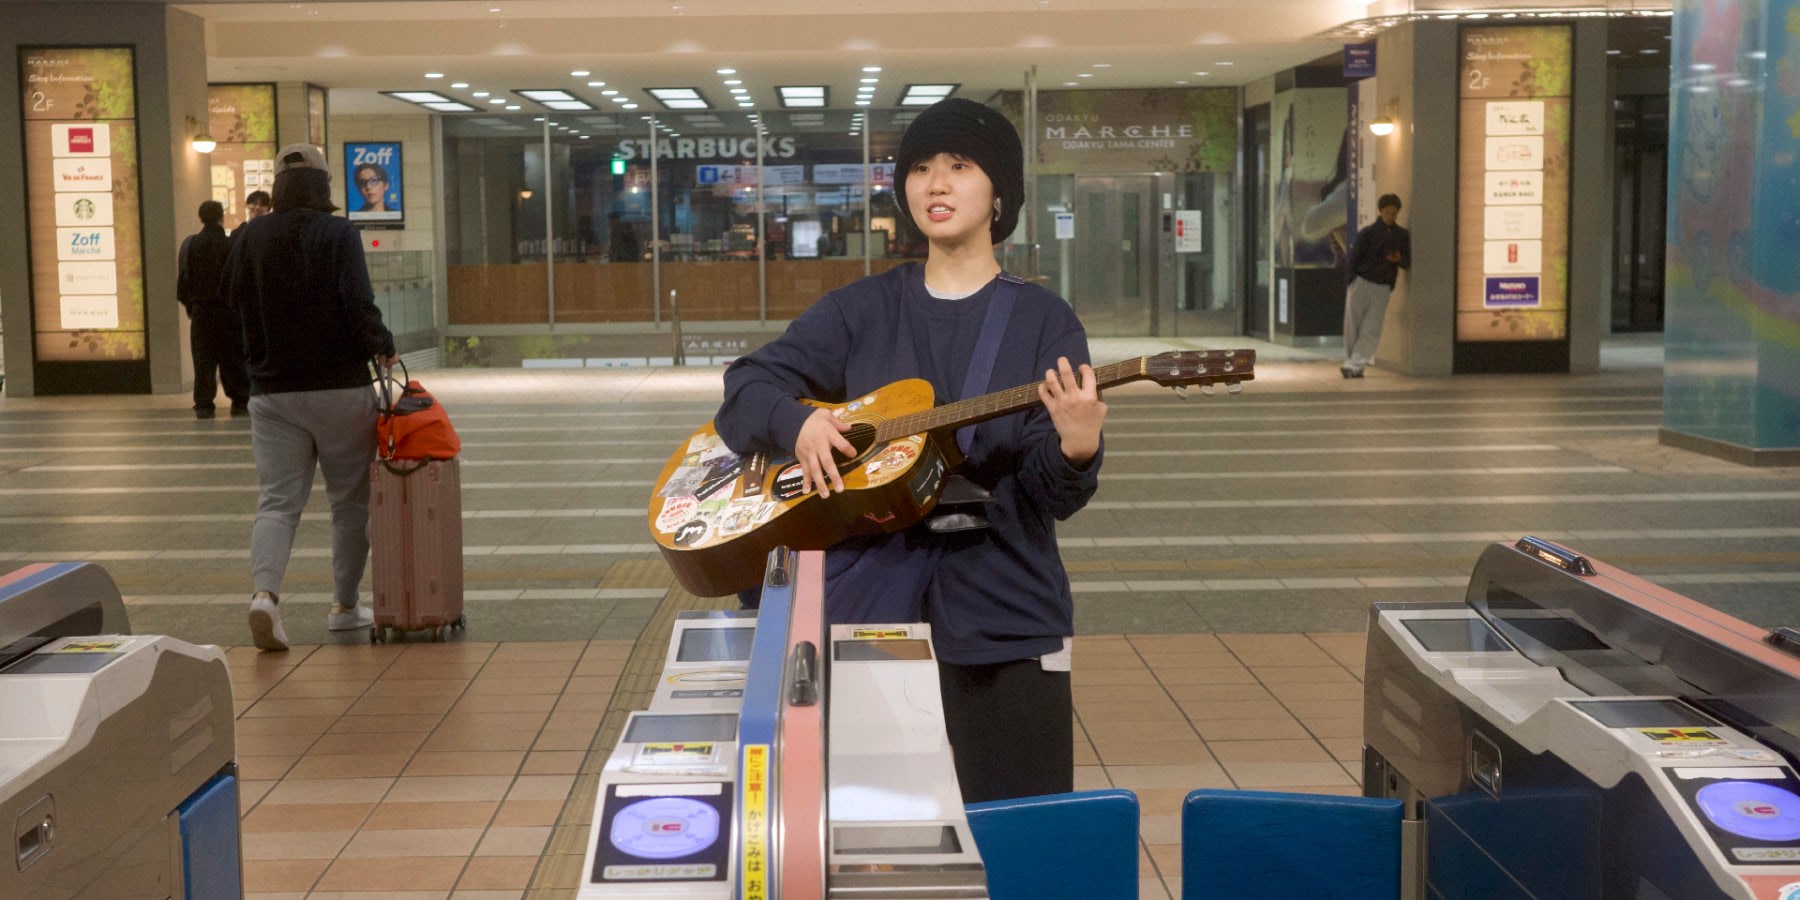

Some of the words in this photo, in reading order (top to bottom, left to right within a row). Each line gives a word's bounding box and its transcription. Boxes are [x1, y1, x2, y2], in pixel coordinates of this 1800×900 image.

[1469, 69, 1490, 90] 2F
[32, 91, 54, 112] 2F
[1046, 114, 1099, 122] ODAKYU
[618, 137, 796, 160] STARBUCKS
[1062, 141, 1104, 149] ODAKYU
[1107, 140, 1136, 149] TAMA
[1138, 139, 1176, 148] CENTER
[353, 147, 393, 166] Zoff
[71, 233, 101, 246] Zoff
